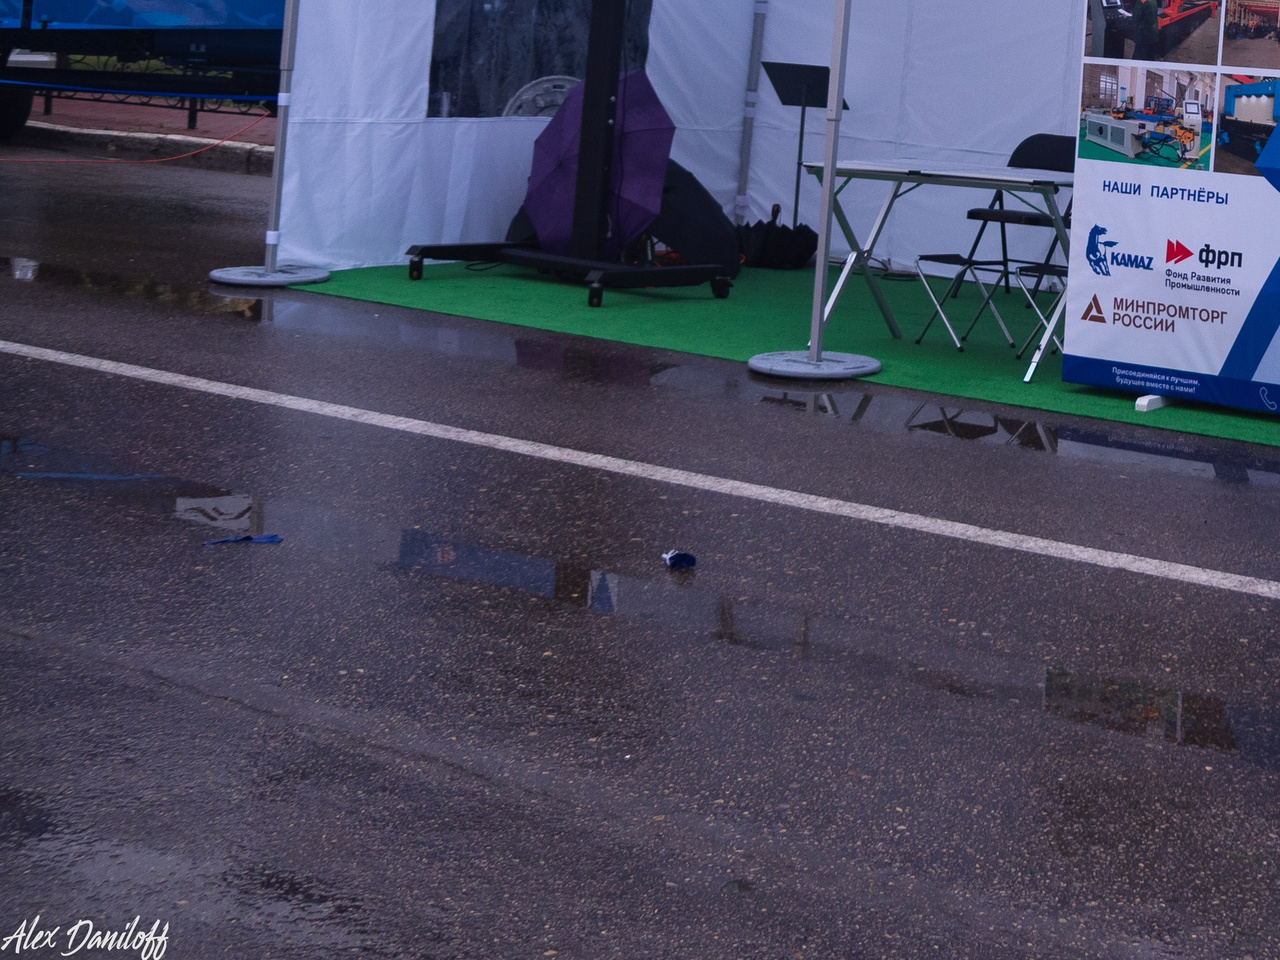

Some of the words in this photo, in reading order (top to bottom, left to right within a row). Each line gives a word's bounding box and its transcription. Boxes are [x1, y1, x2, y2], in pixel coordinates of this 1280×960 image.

[1102, 180, 1141, 196] НАШИ
[1150, 185, 1229, 205] ПАРТНЁРЫ
[1110, 251, 1154, 271] KAMAZ
[1165, 268, 1189, 281] Фонд
[1191, 271, 1231, 285] Развития
[1165, 279, 1240, 296] Промышленности
[1113, 297, 1228, 325] МИНПРОМТОРГ
[1112, 312, 1175, 333] РОССИИ
[1112, 366, 1165, 380] Присоединяйся
[1115, 376, 1145, 386] будущее
[1145, 381, 1169, 390] вместе
